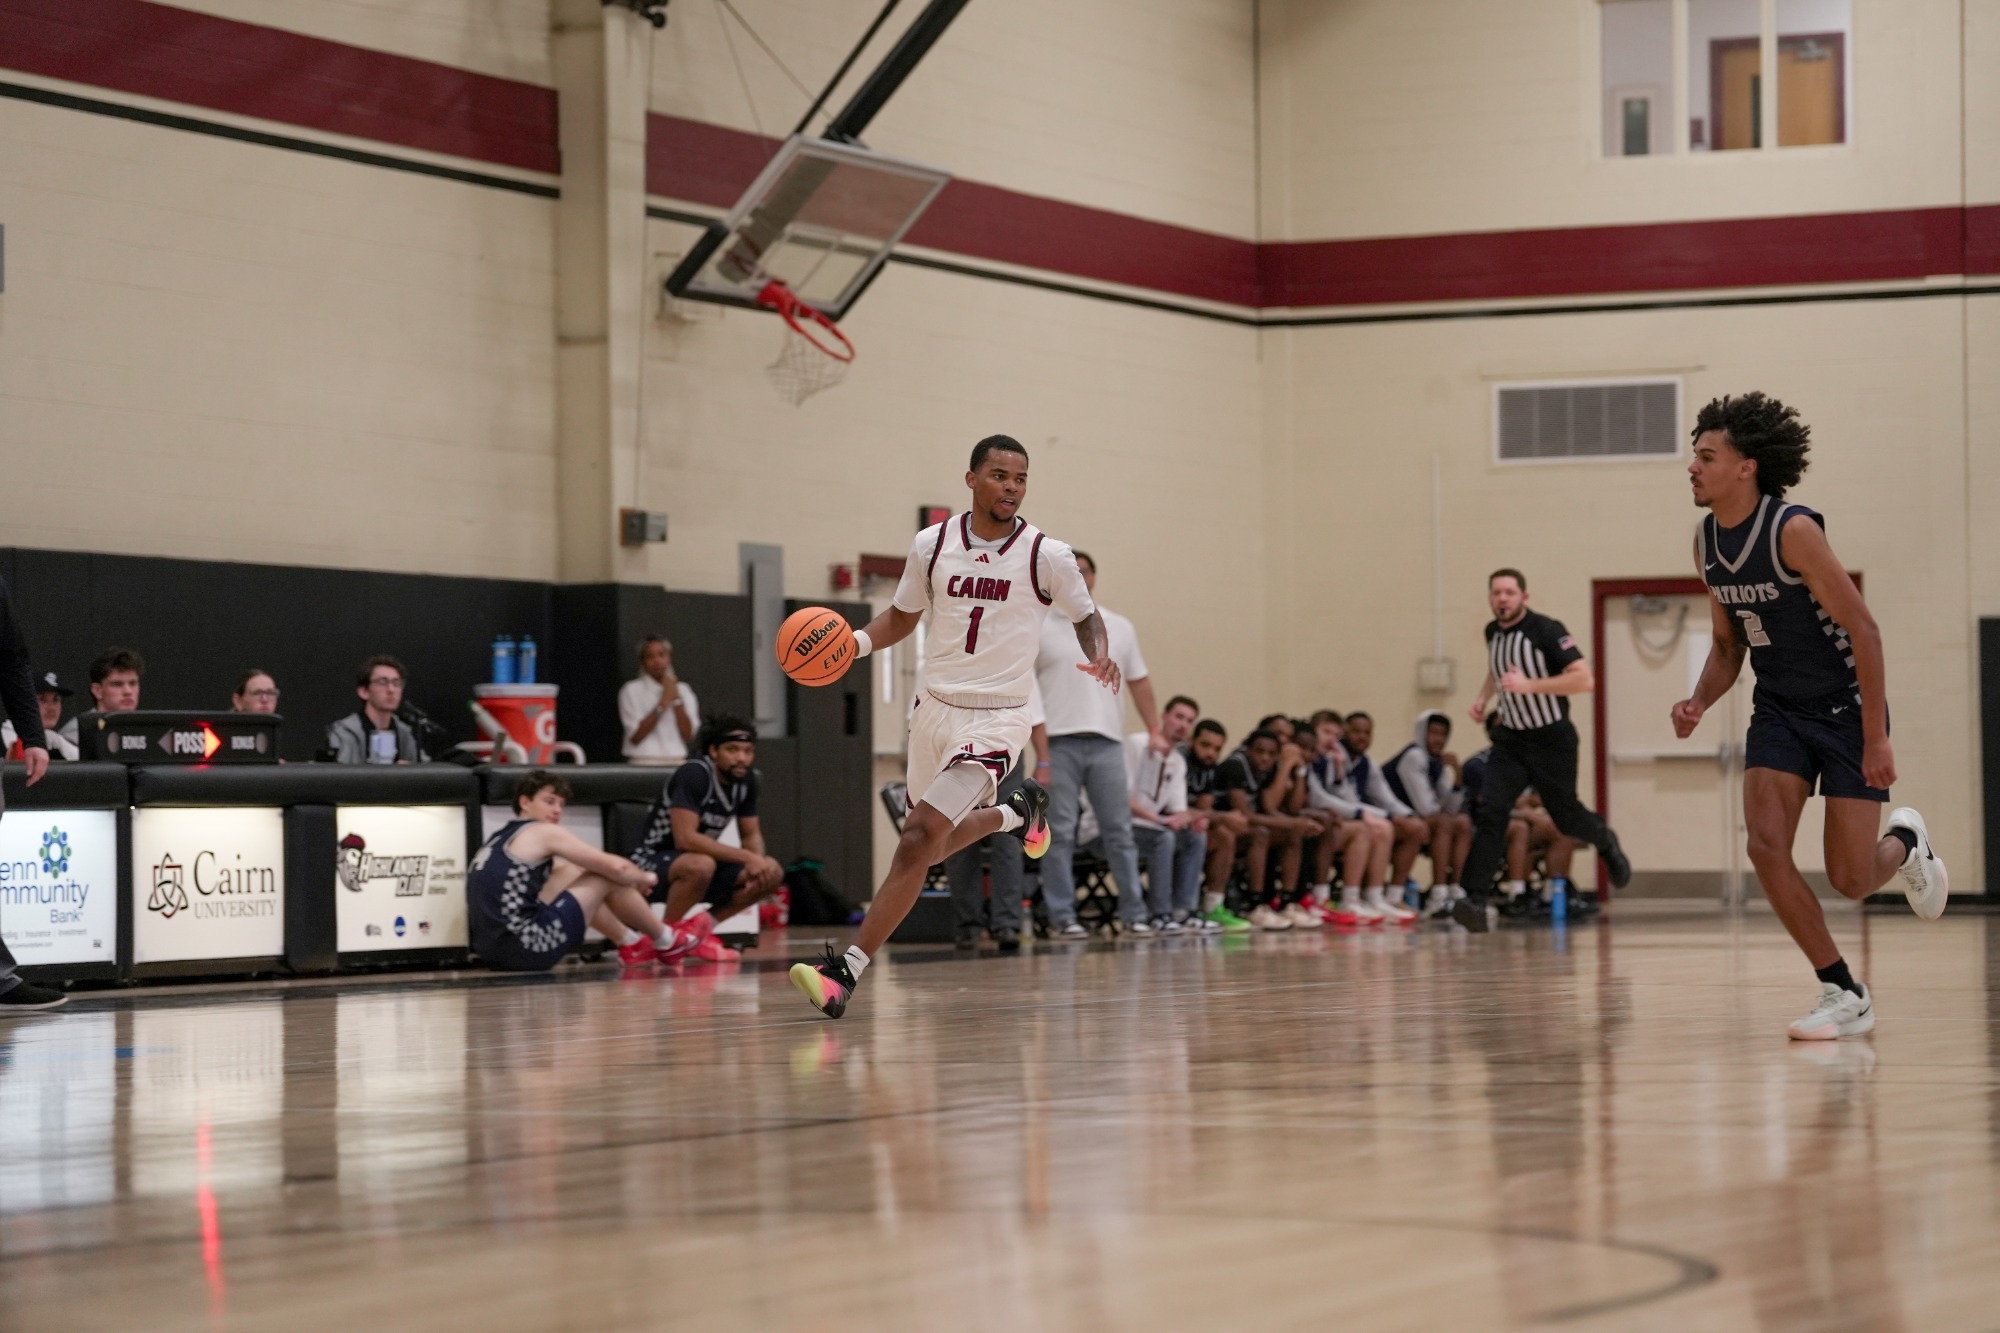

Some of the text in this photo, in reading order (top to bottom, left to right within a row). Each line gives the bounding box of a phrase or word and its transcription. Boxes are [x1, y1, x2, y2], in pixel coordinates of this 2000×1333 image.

[947, 575, 1012, 602] CAIRN
[795, 618, 840, 657] Wilson
[965, 606, 984, 655] 1
[1736, 610, 1771, 647] 2
[122, 735, 147, 750] BONUS
[174, 731, 205, 754] POSS
[231, 735, 255, 750] BONUS
[193, 850, 277, 896] Cairn
[50, 908, 82, 924] Bank
[194, 899, 277, 919] UNIVERSITY
